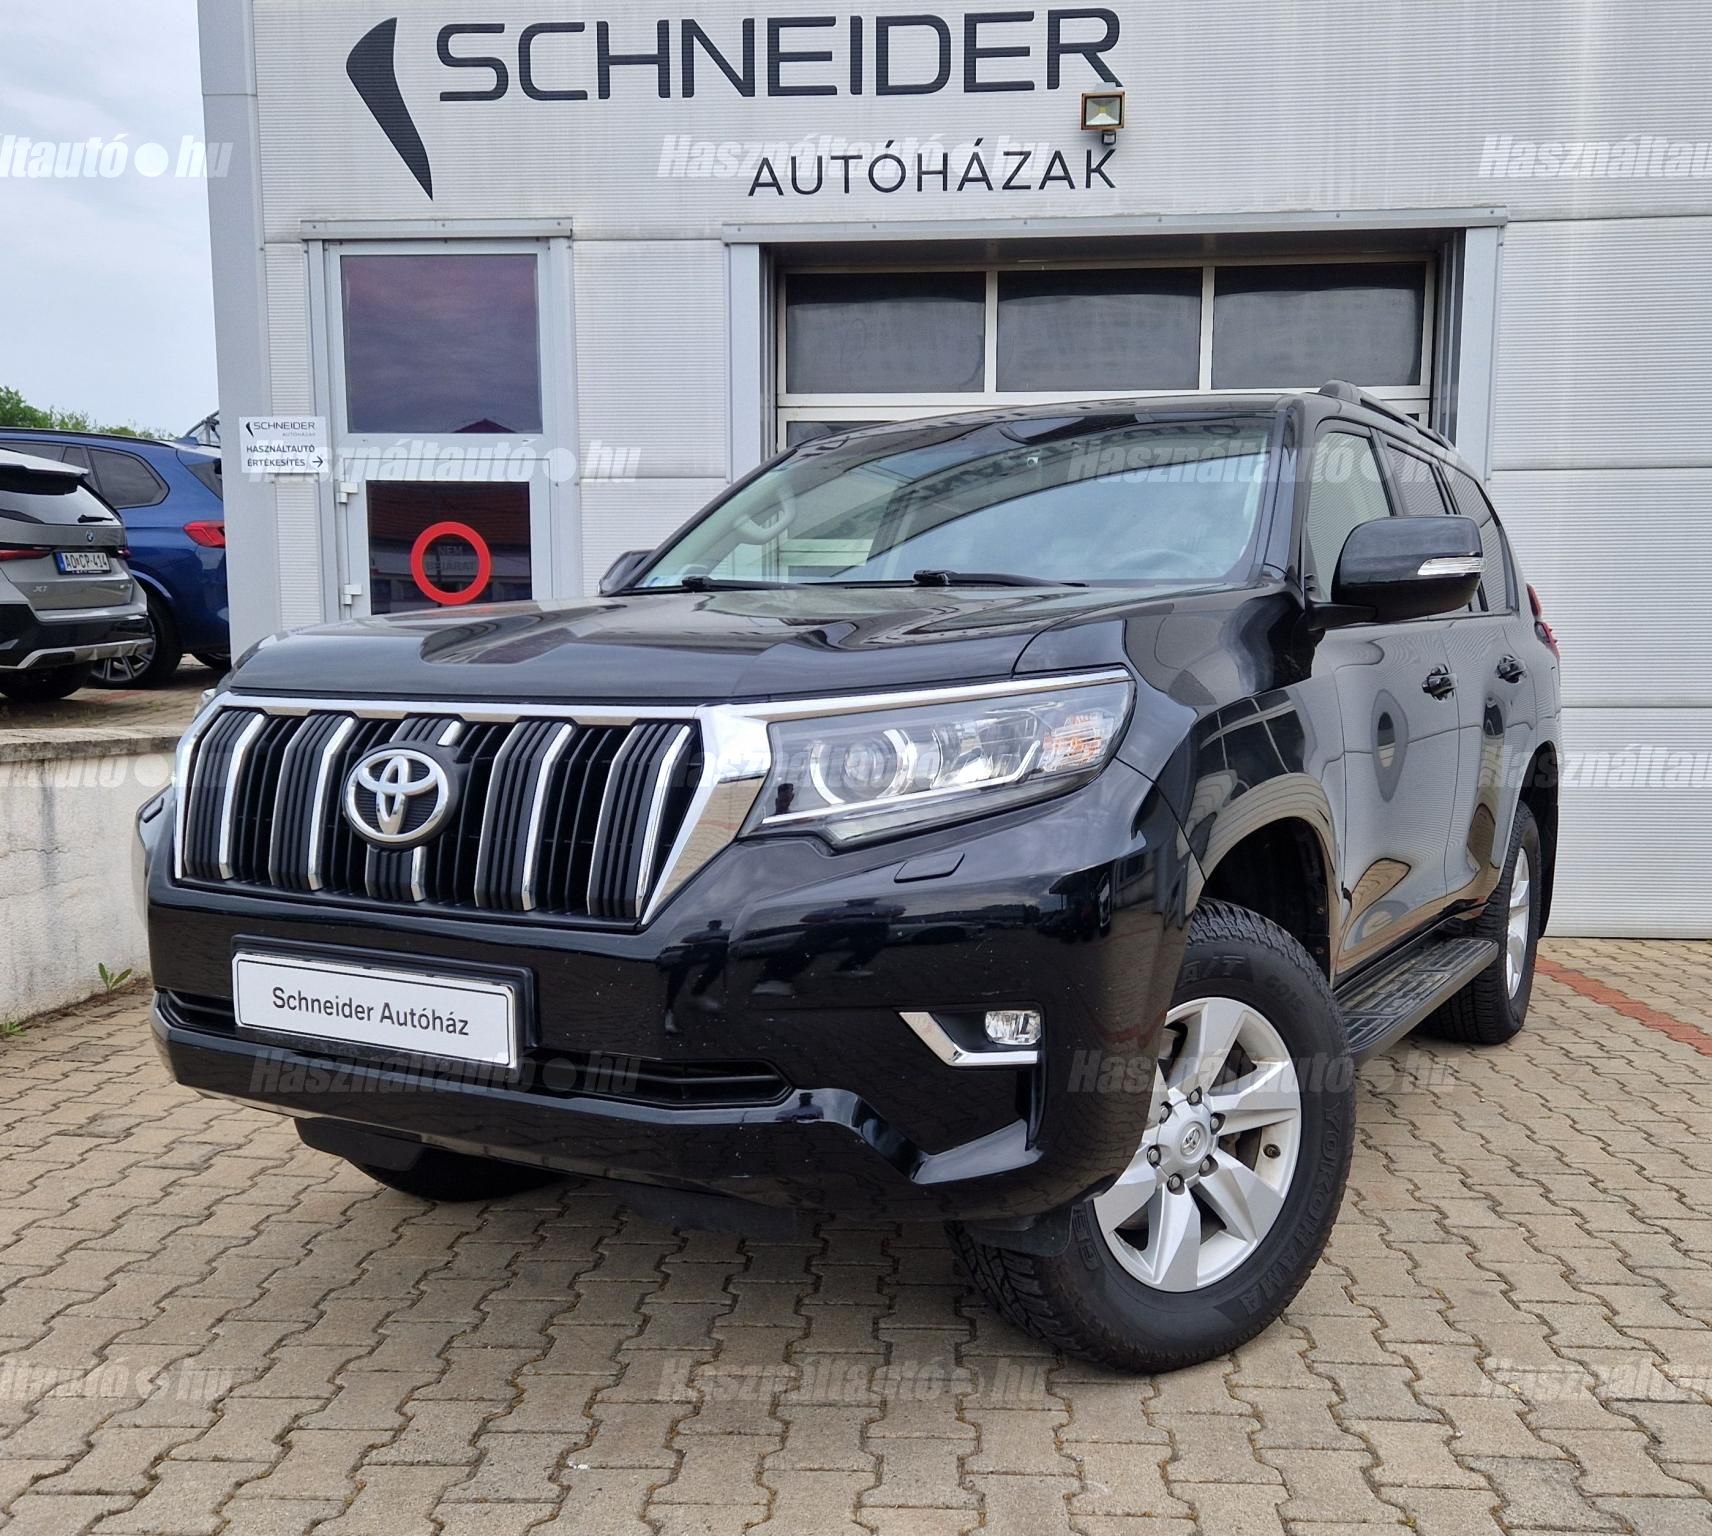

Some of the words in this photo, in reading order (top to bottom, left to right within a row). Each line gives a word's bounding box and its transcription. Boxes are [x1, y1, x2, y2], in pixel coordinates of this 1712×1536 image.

[436, 7, 1123, 102] SCHNEIDER
[747, 137, 1117, 197] AUTÓHÁZAK
[253, 421, 316, 430] SCHNEIDER
[246, 443, 316, 453] HASZNÁLTAUTÓ
[247, 456, 306, 467] ÉRTÉKESÍTÉS
[32, 585, 48, 593] X1
[272, 986, 374, 1021] Schneider
[379, 1001, 469, 1036] Autóház
